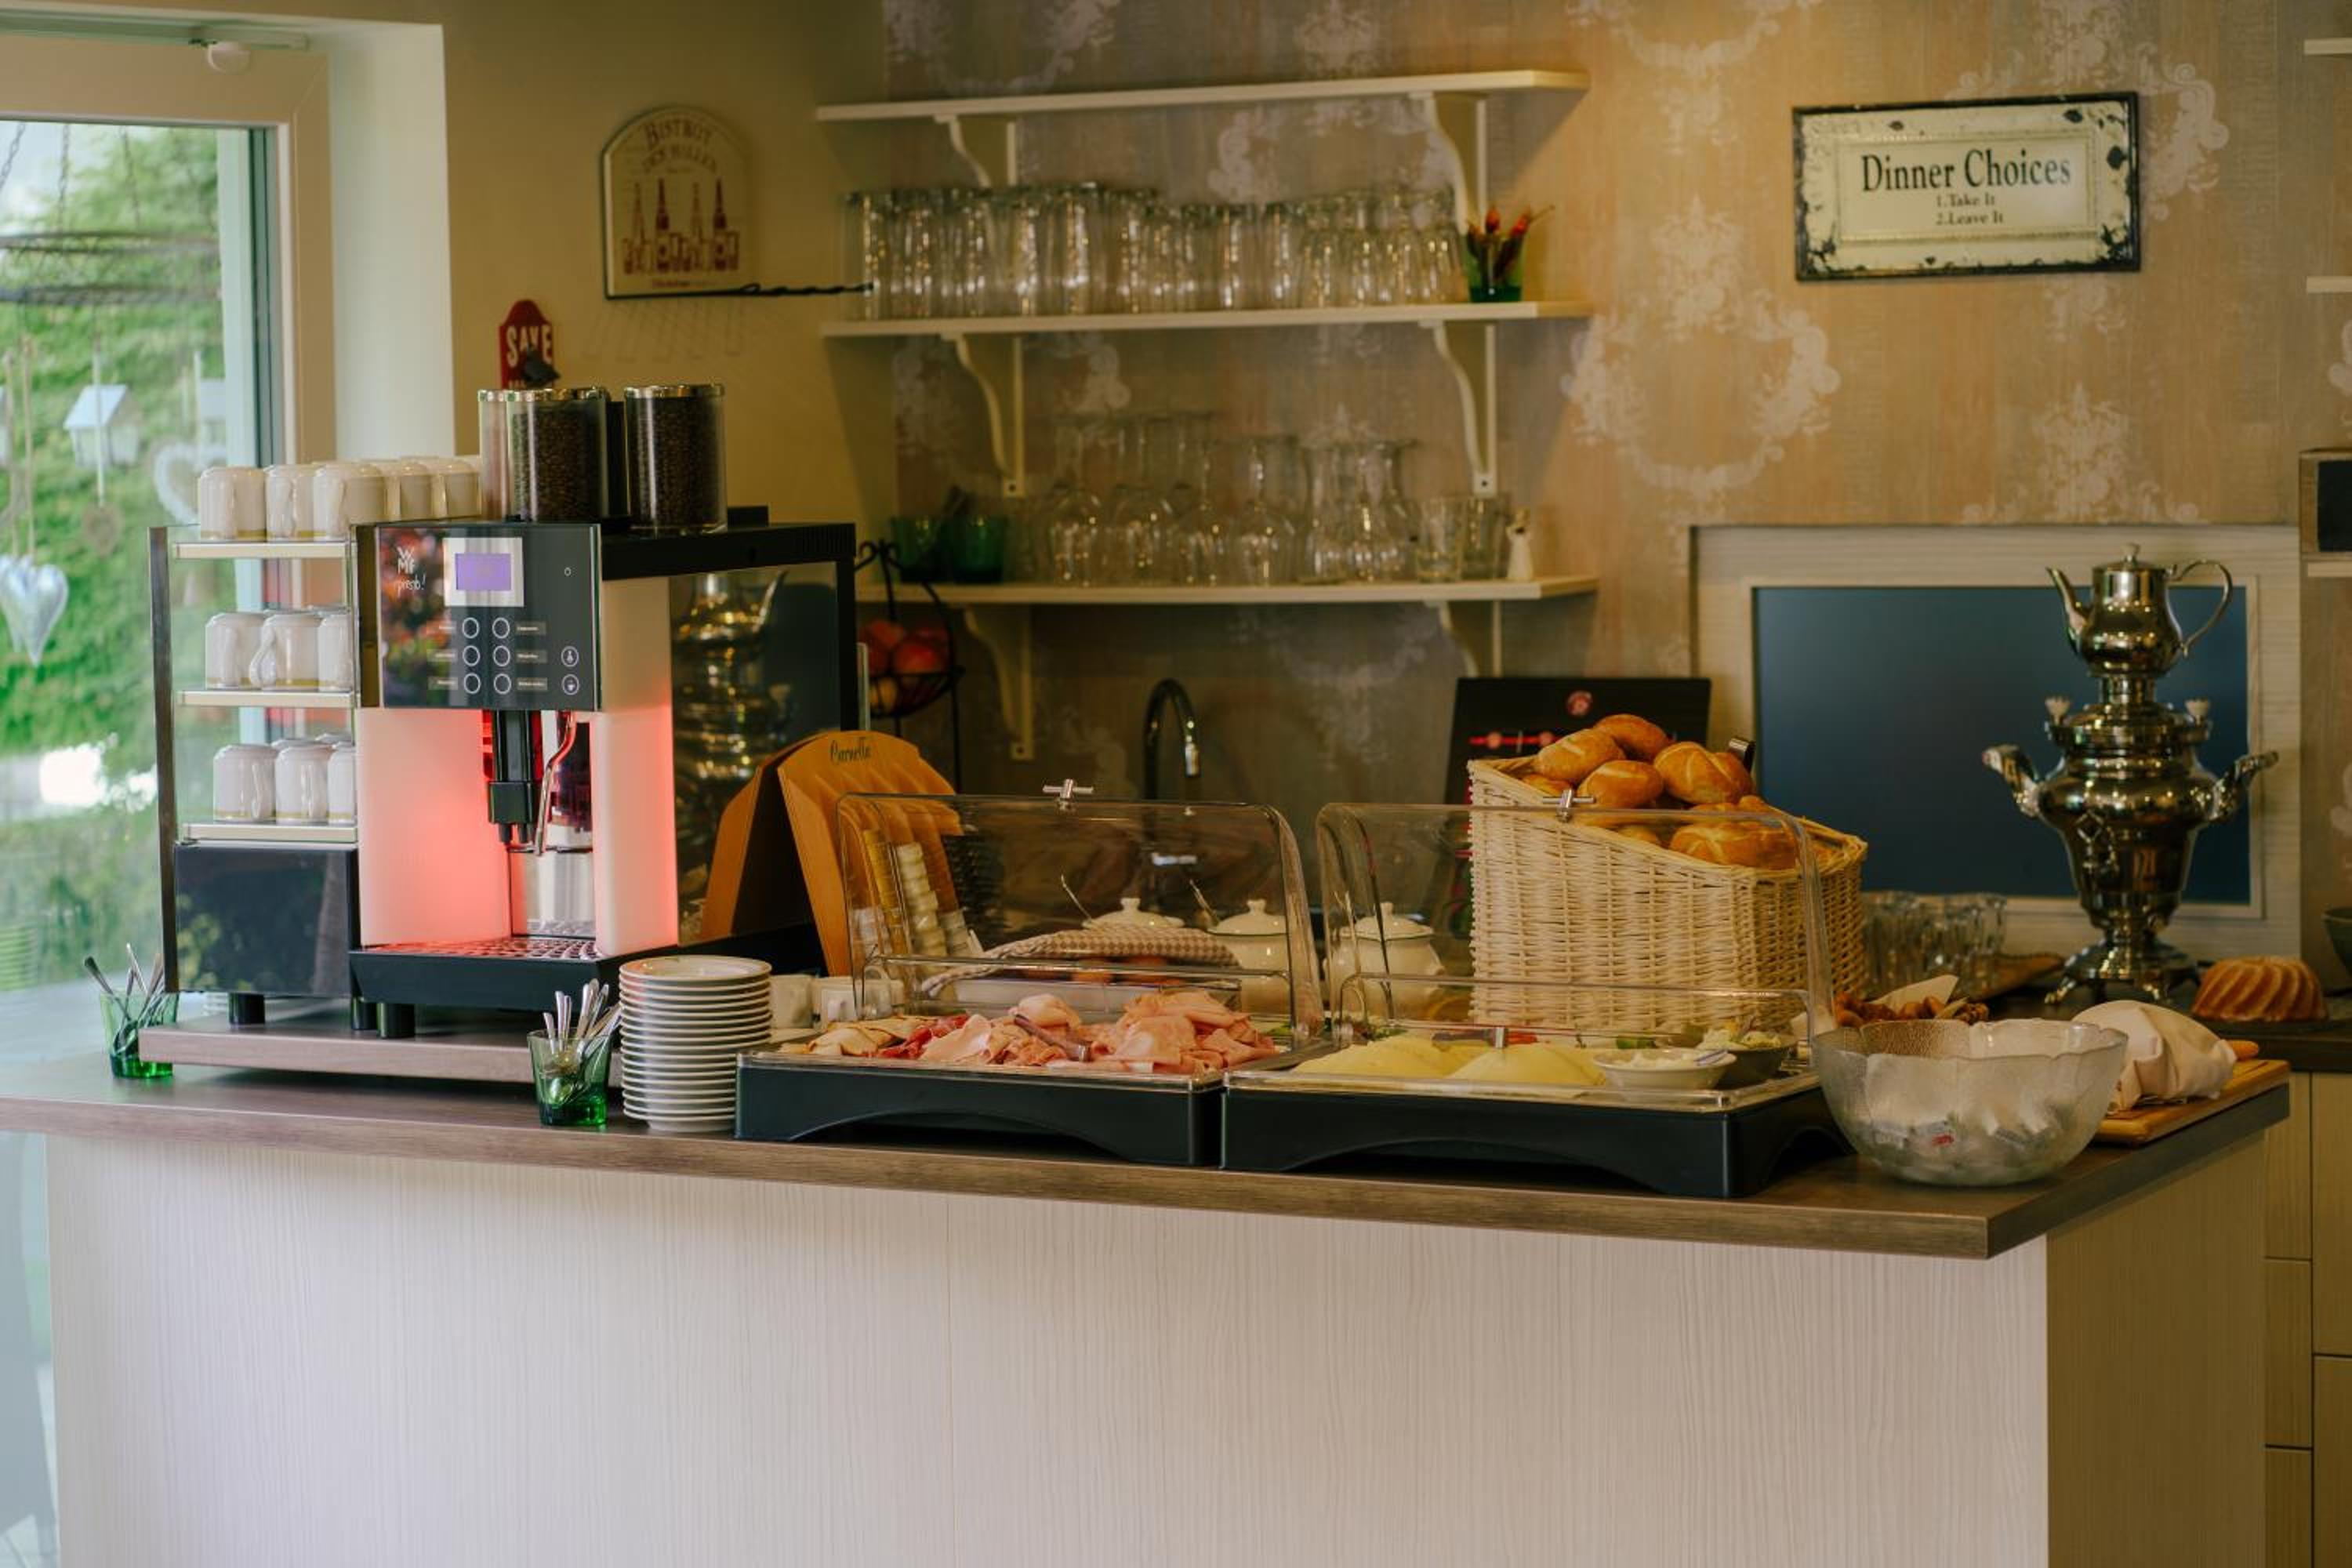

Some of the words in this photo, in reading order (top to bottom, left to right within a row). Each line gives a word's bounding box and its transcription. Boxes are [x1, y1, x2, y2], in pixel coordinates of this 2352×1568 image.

[1861, 154, 1955, 191] Dinner
[1964, 148, 2071, 187] Choices
[1984, 192, 1996, 205] It
[1936, 211, 1988, 226] 2.Leave
[1993, 210, 2004, 223] It
[506, 325, 553, 368] SAVE
[397, 546, 416, 574] WMF
